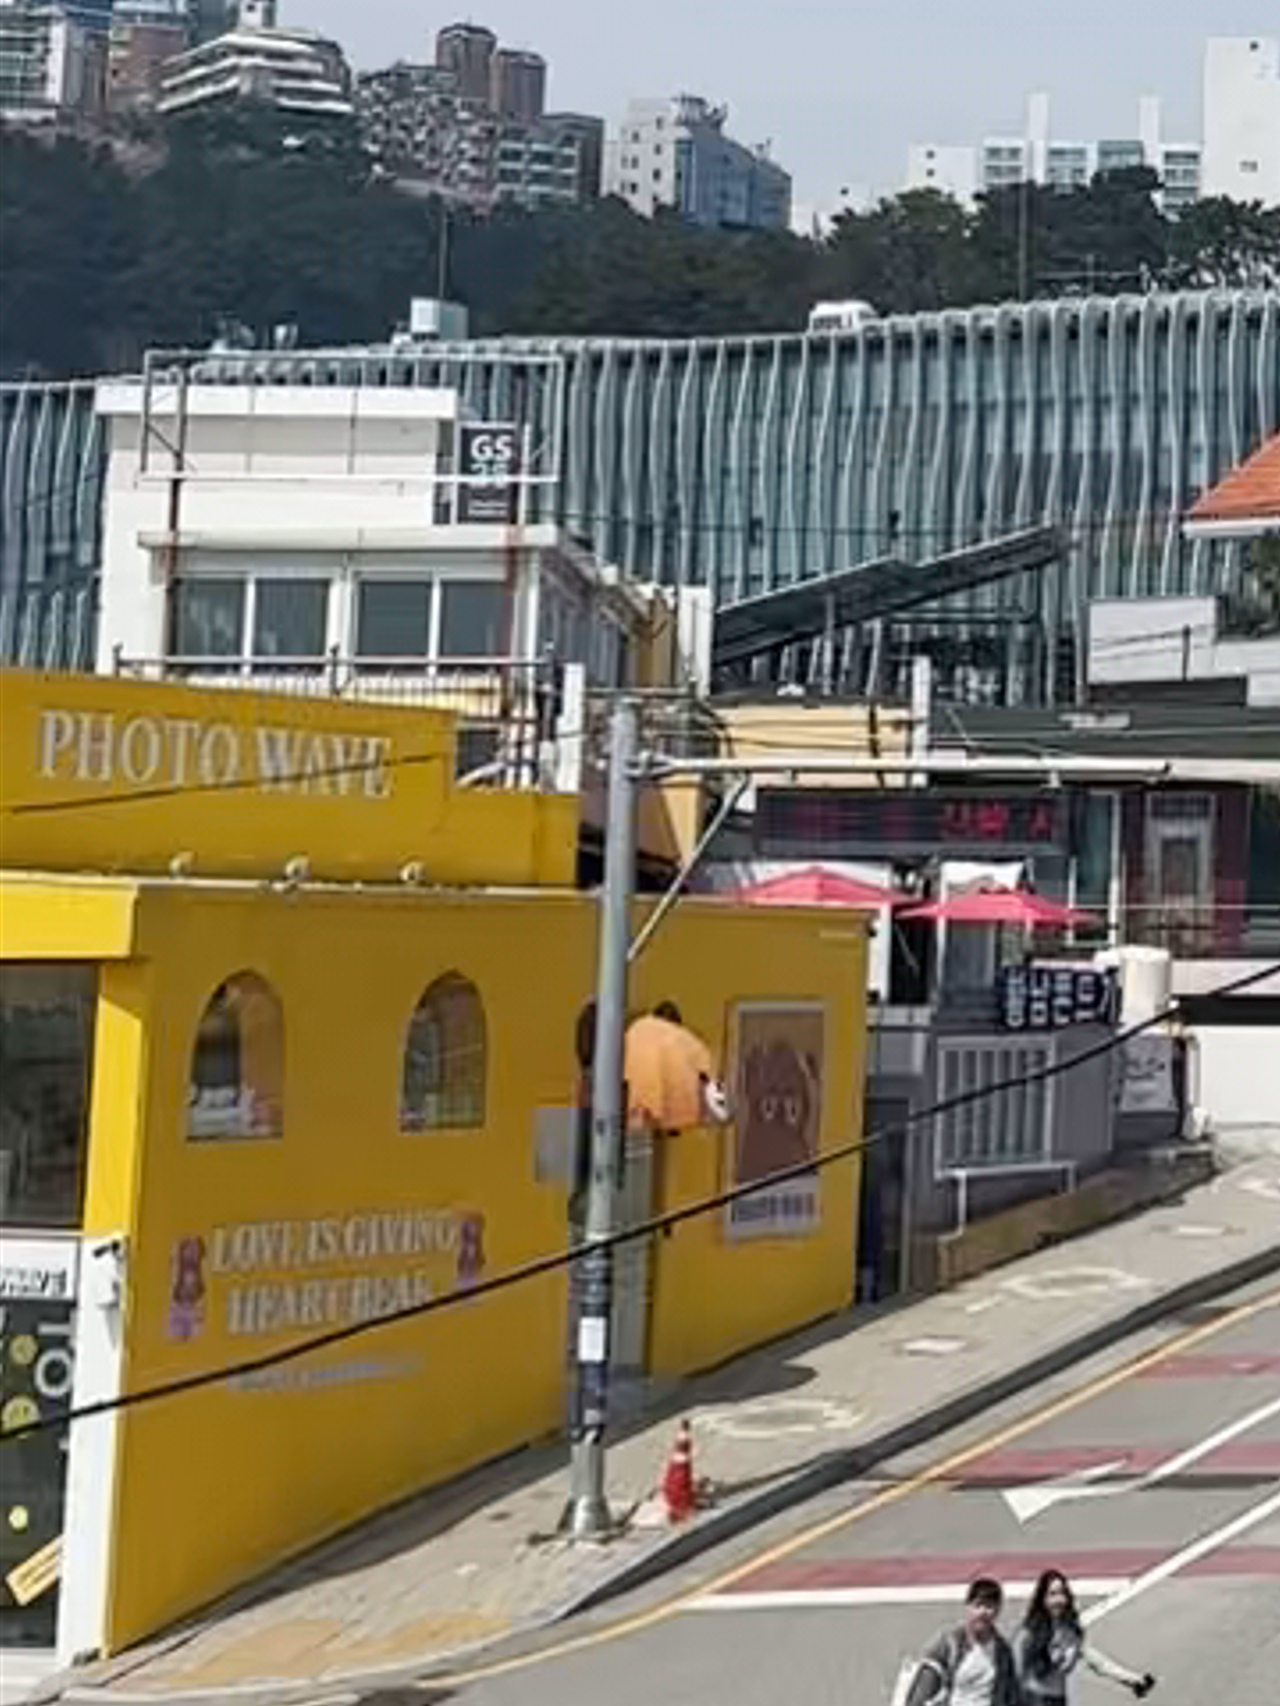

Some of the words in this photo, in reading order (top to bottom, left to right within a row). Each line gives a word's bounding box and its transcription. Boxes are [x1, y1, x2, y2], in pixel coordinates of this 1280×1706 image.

[470, 434, 512, 462] GS
[38, 708, 240, 789] PHOTO
[254, 726, 393, 799] WAVE
[211, 1220, 302, 1274] LOVE
[307, 1217, 339, 1263] IS
[344, 1208, 457, 1257] GIVING
[227, 1278, 346, 1334] HEART
